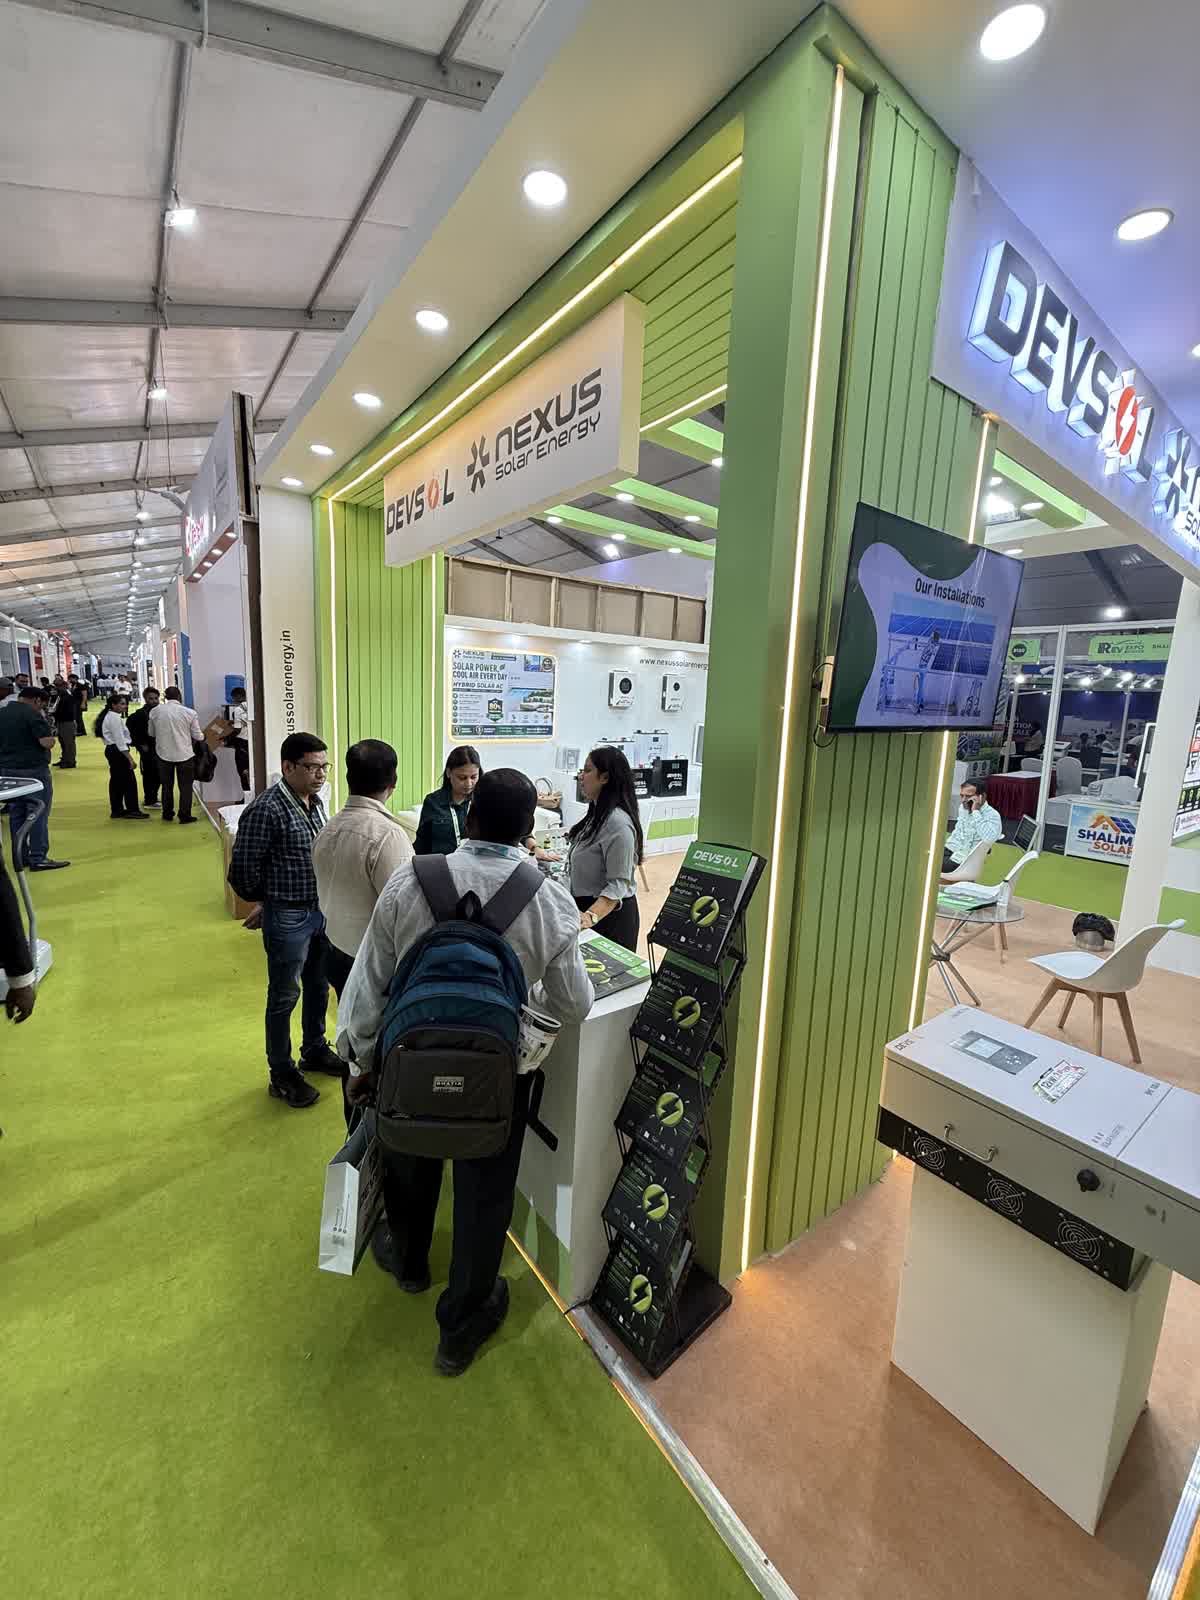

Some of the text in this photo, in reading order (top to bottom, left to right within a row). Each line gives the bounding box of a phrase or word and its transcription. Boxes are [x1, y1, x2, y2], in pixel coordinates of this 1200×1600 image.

[968, 240, 1153, 483] DEVSOL
[386, 468, 454, 536] DEVSOL
[914, 577, 986, 609] Our Installations
[280, 629, 295, 736] ussolarenergy.in
[452, 662, 475, 671] SOLAR
[452, 671, 468, 679] COOL
[480, 672, 497, 680] EVERY
[497, 673, 508, 681] DAY
